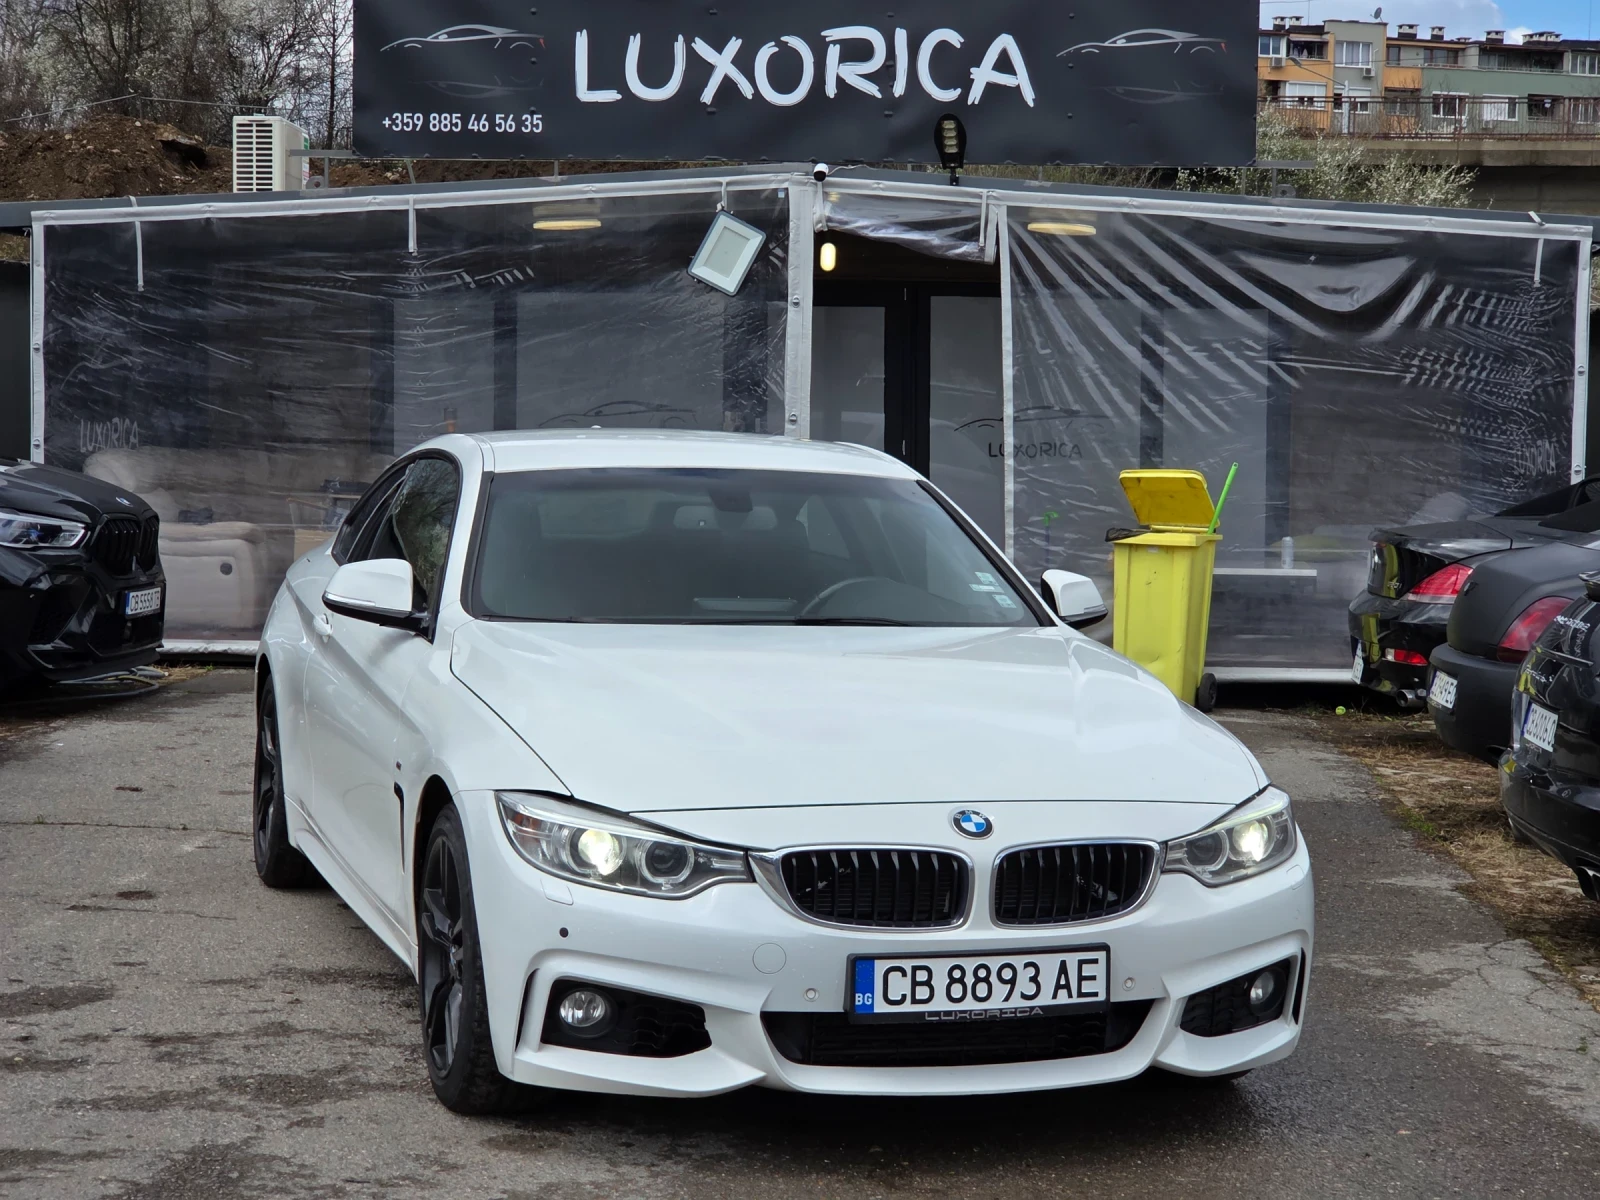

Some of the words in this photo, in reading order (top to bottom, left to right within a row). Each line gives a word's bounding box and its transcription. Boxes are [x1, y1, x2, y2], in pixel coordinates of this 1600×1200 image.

[574, 25, 1035, 107] LUXORICA
[382, 112, 424, 132] +359
[429, 113, 462, 132] 885
[468, 113, 490, 132] 46
[495, 114, 516, 133] 56
[521, 114, 543, 133] 35
[882, 964, 935, 1006] CB
[945, 961, 1042, 1004] 8893
[1051, 957, 1099, 1000] AE
[855, 992, 872, 1005] BG
[925, 1006, 1044, 1021] LUXORICA
